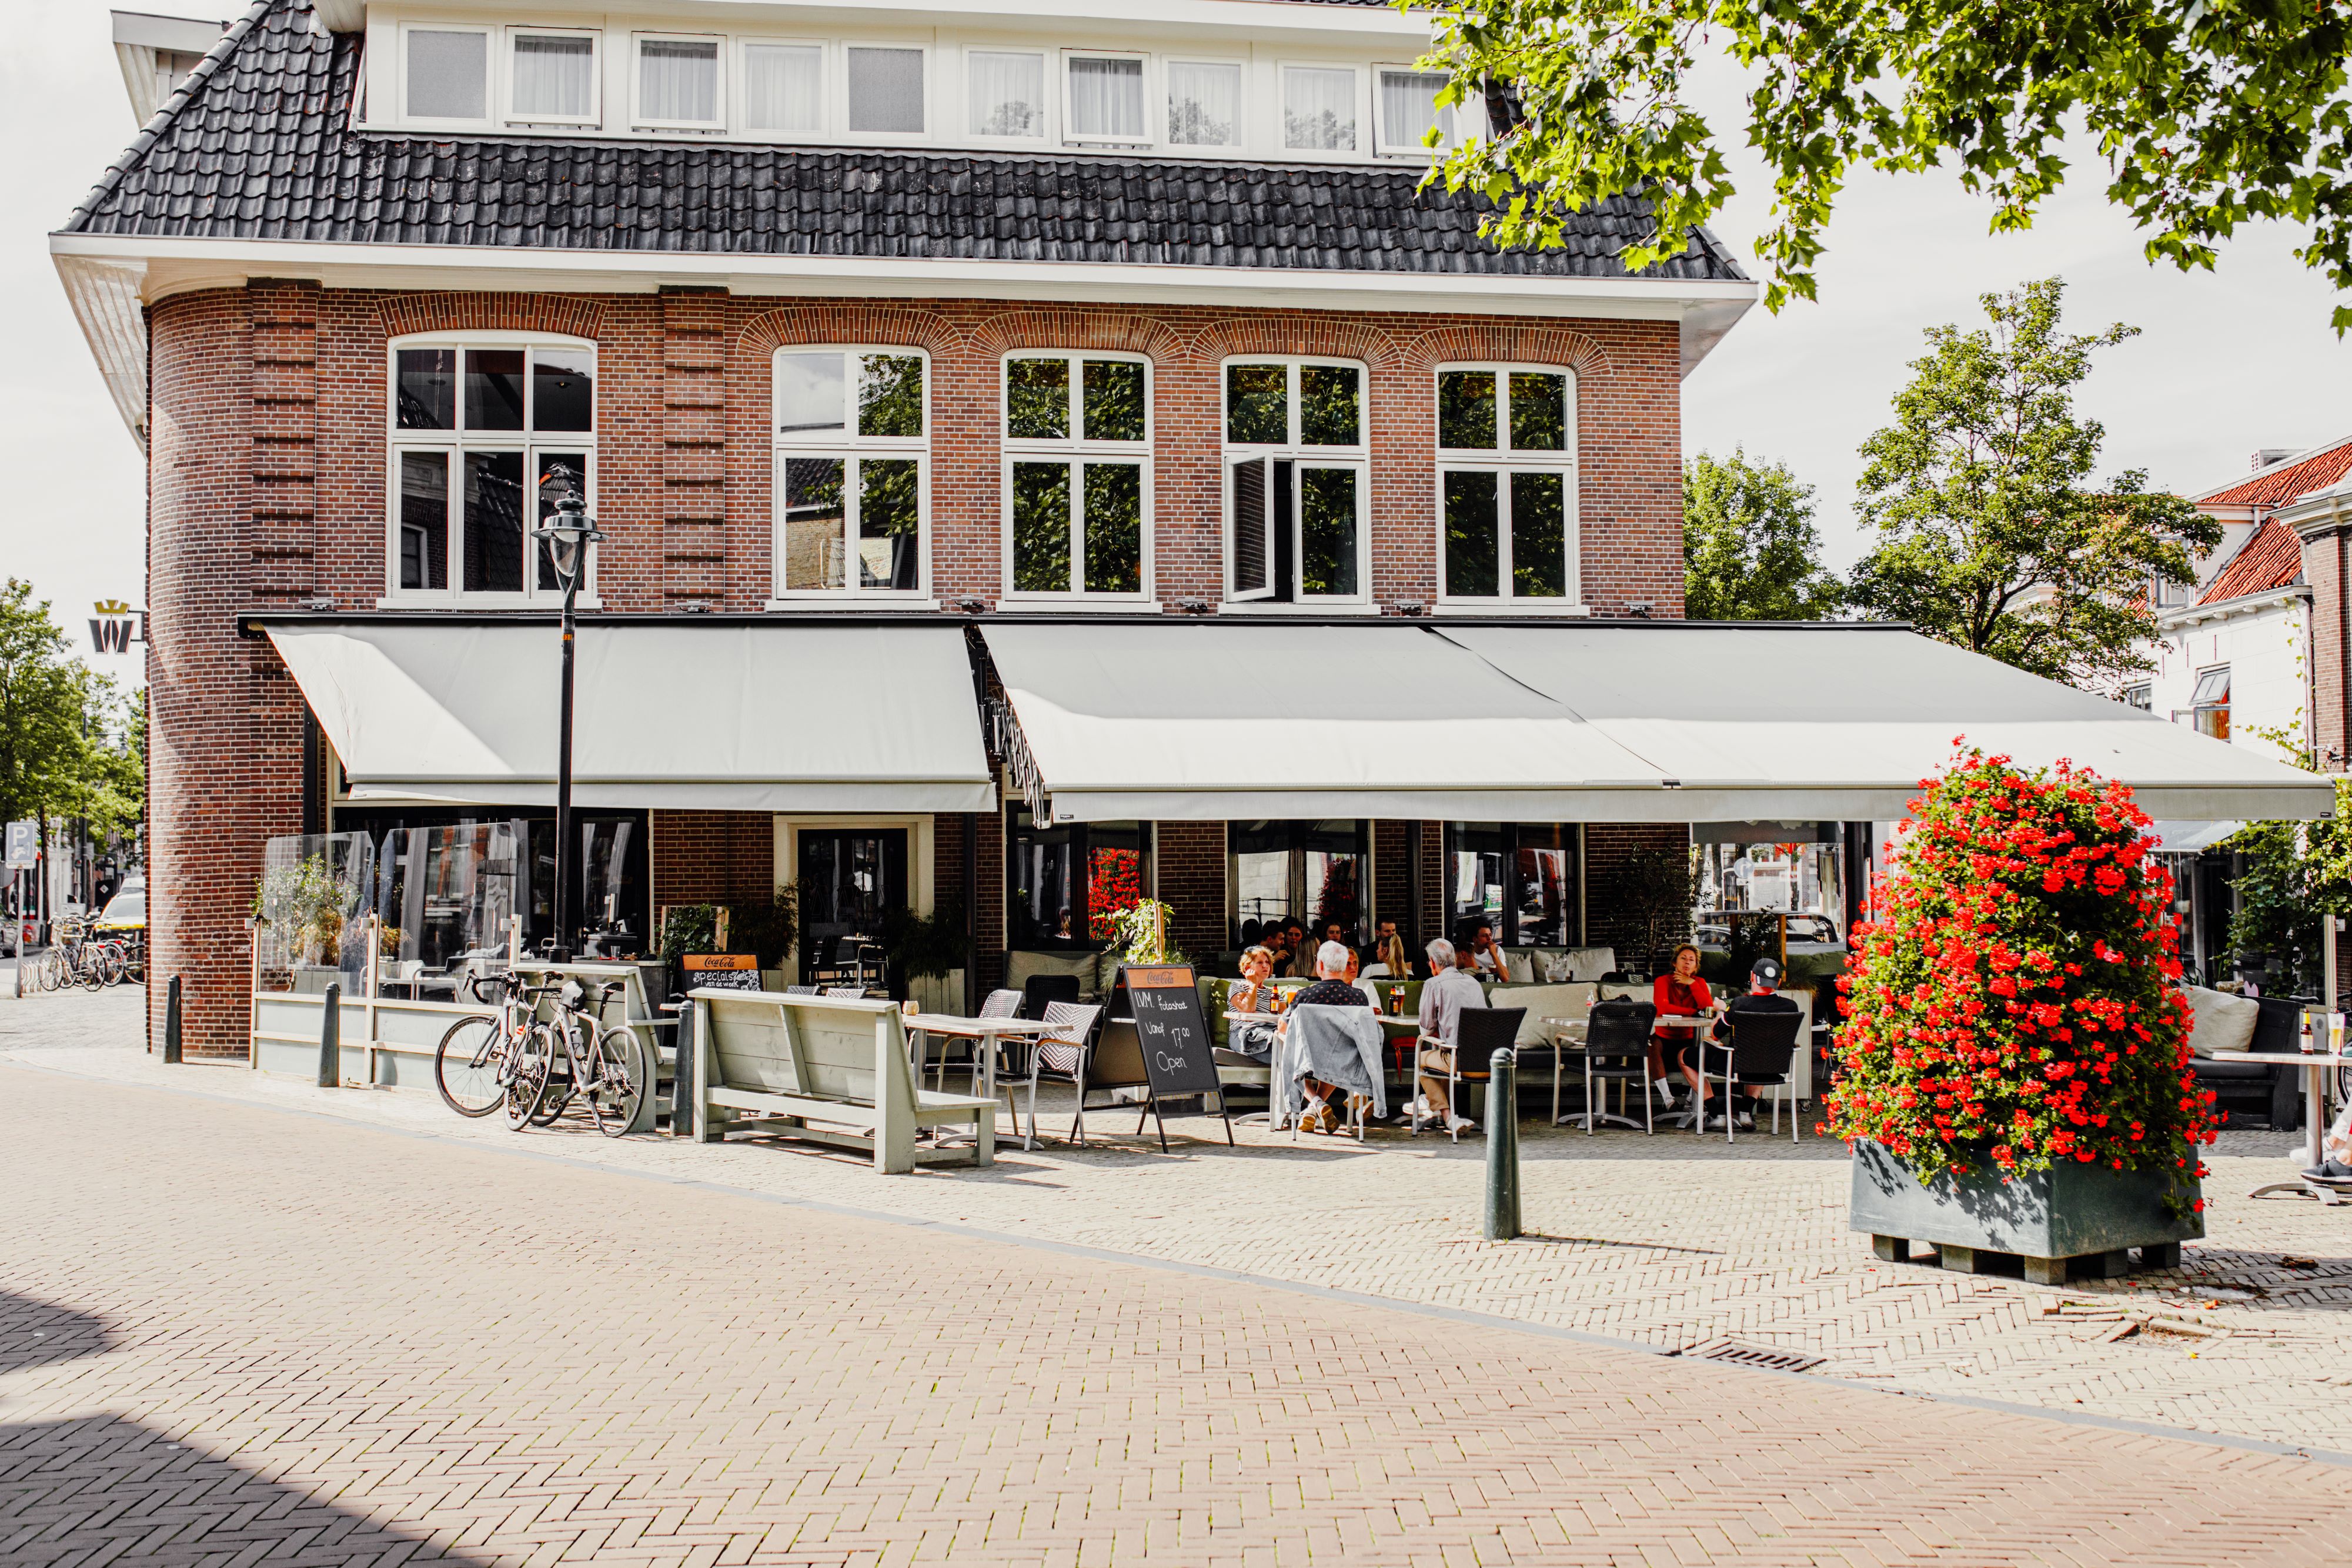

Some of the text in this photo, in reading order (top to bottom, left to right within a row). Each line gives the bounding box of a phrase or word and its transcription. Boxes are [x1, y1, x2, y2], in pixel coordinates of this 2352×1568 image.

[88, 619, 134, 654] W
[14, 826, 28, 845] P
[693, 971, 733, 985] specials
[1145, 1022, 1165, 1037] Vanaf
